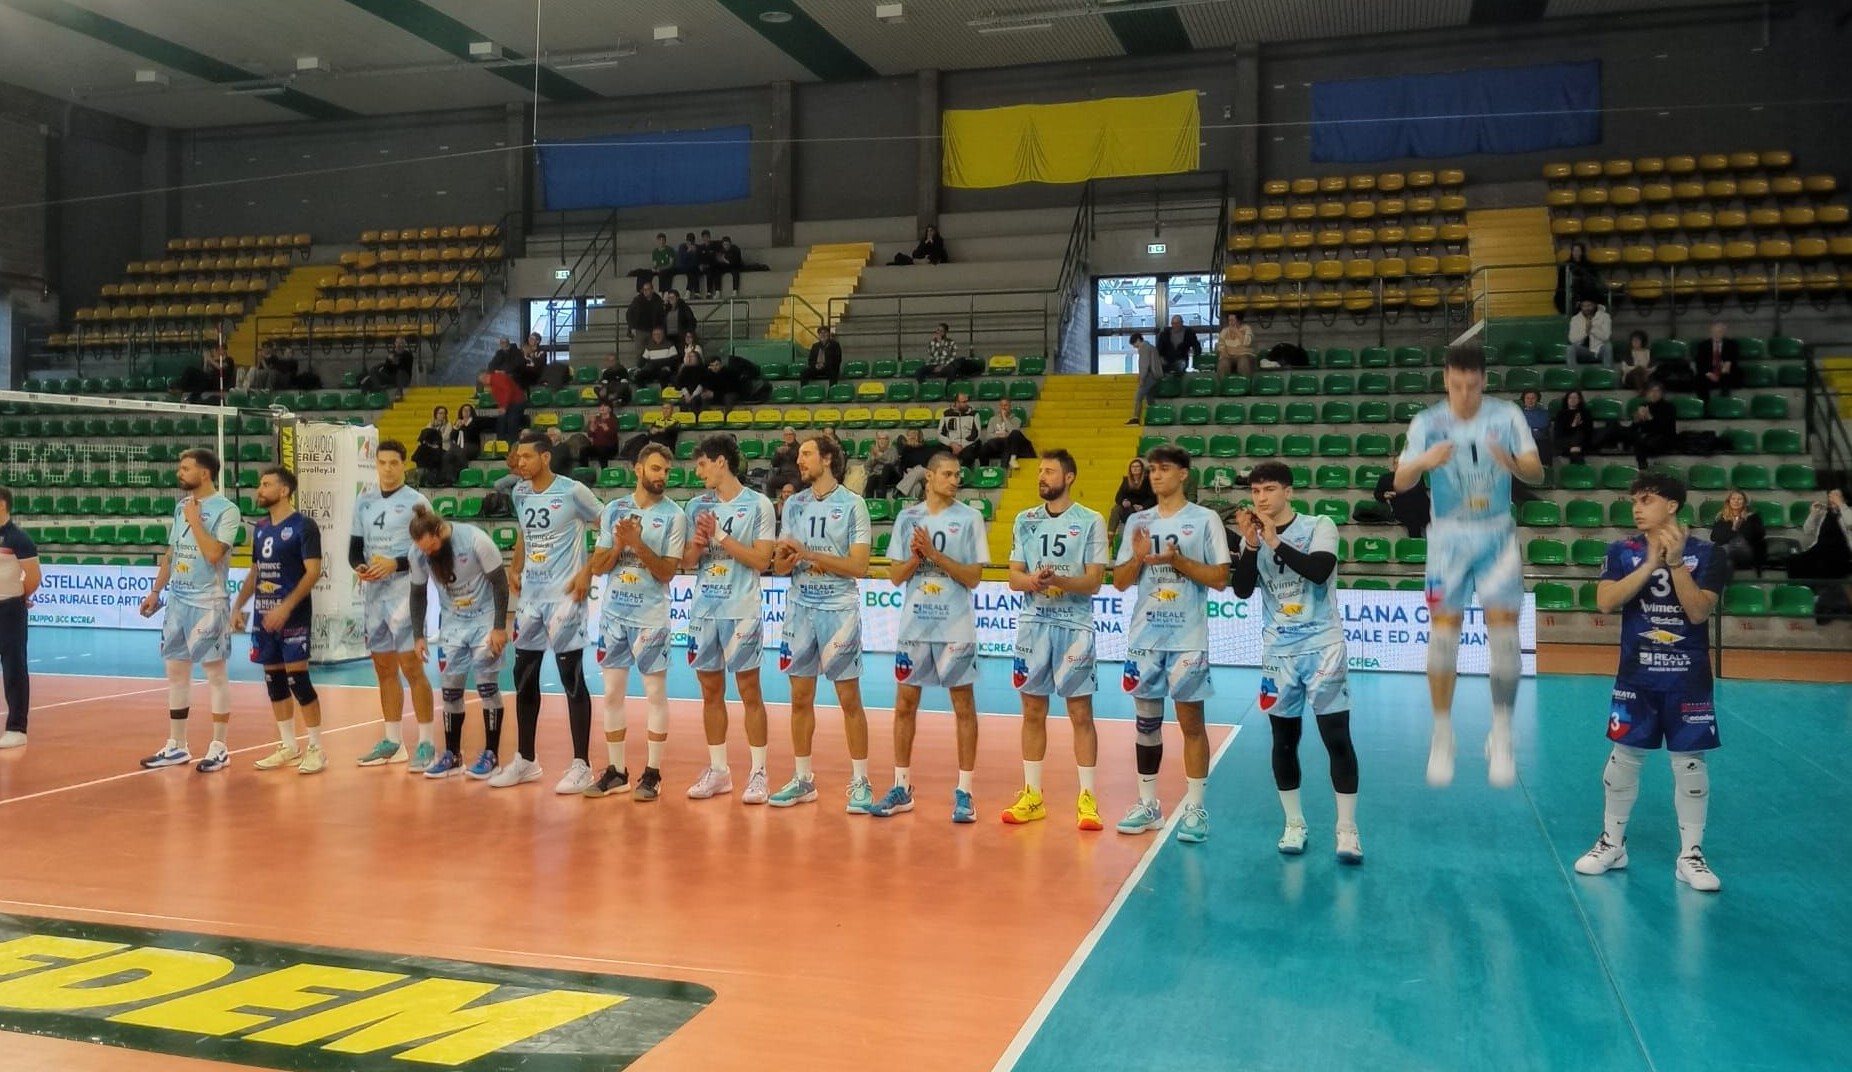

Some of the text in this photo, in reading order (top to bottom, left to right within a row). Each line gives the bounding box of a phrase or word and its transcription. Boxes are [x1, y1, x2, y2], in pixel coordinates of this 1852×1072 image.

[373, 511, 386, 530] 4
[525, 508, 551, 529] 23
[808, 516, 827, 538] 11
[261, 537, 274, 559] 8
[1040, 533, 1067, 557] 15
[1650, 568, 1672, 598] 3
[59, 595, 98, 606] RURALE
[101, 596, 116, 607] ED
[866, 591, 902, 608] BCC
[1206, 601, 1249, 618] BCC
[1389, 631, 1410, 644] ED
[1601, 711, 1610, 731] 3
